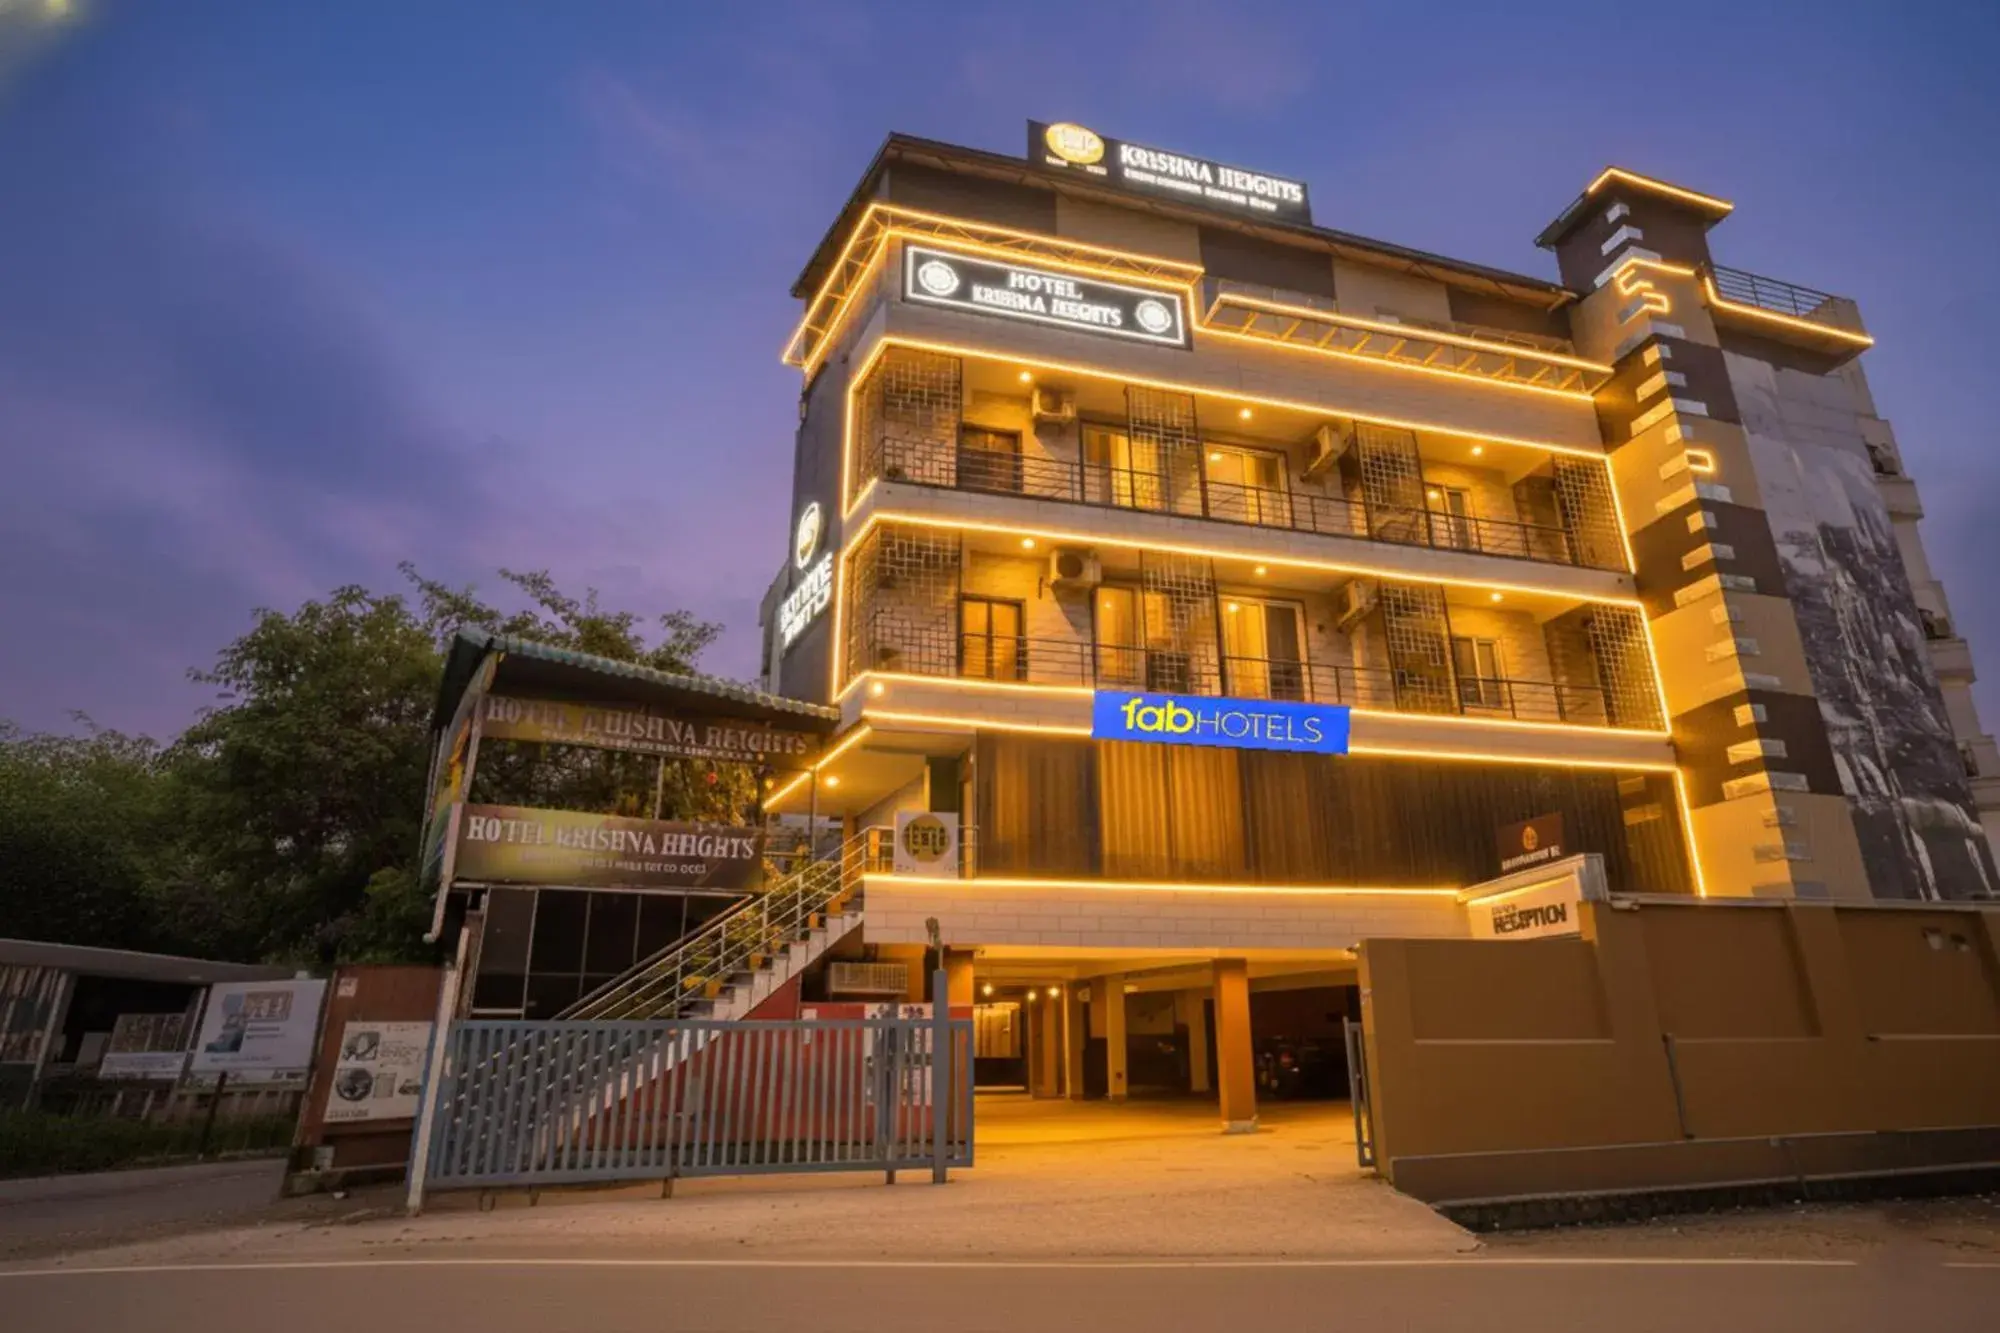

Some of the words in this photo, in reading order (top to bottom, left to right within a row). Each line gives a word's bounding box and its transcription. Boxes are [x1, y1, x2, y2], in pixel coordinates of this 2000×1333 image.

[1120, 144, 1213, 183] KRISHNA
[1009, 272, 1083, 300] HOTEL
[466, 815, 549, 844] HOTEL
